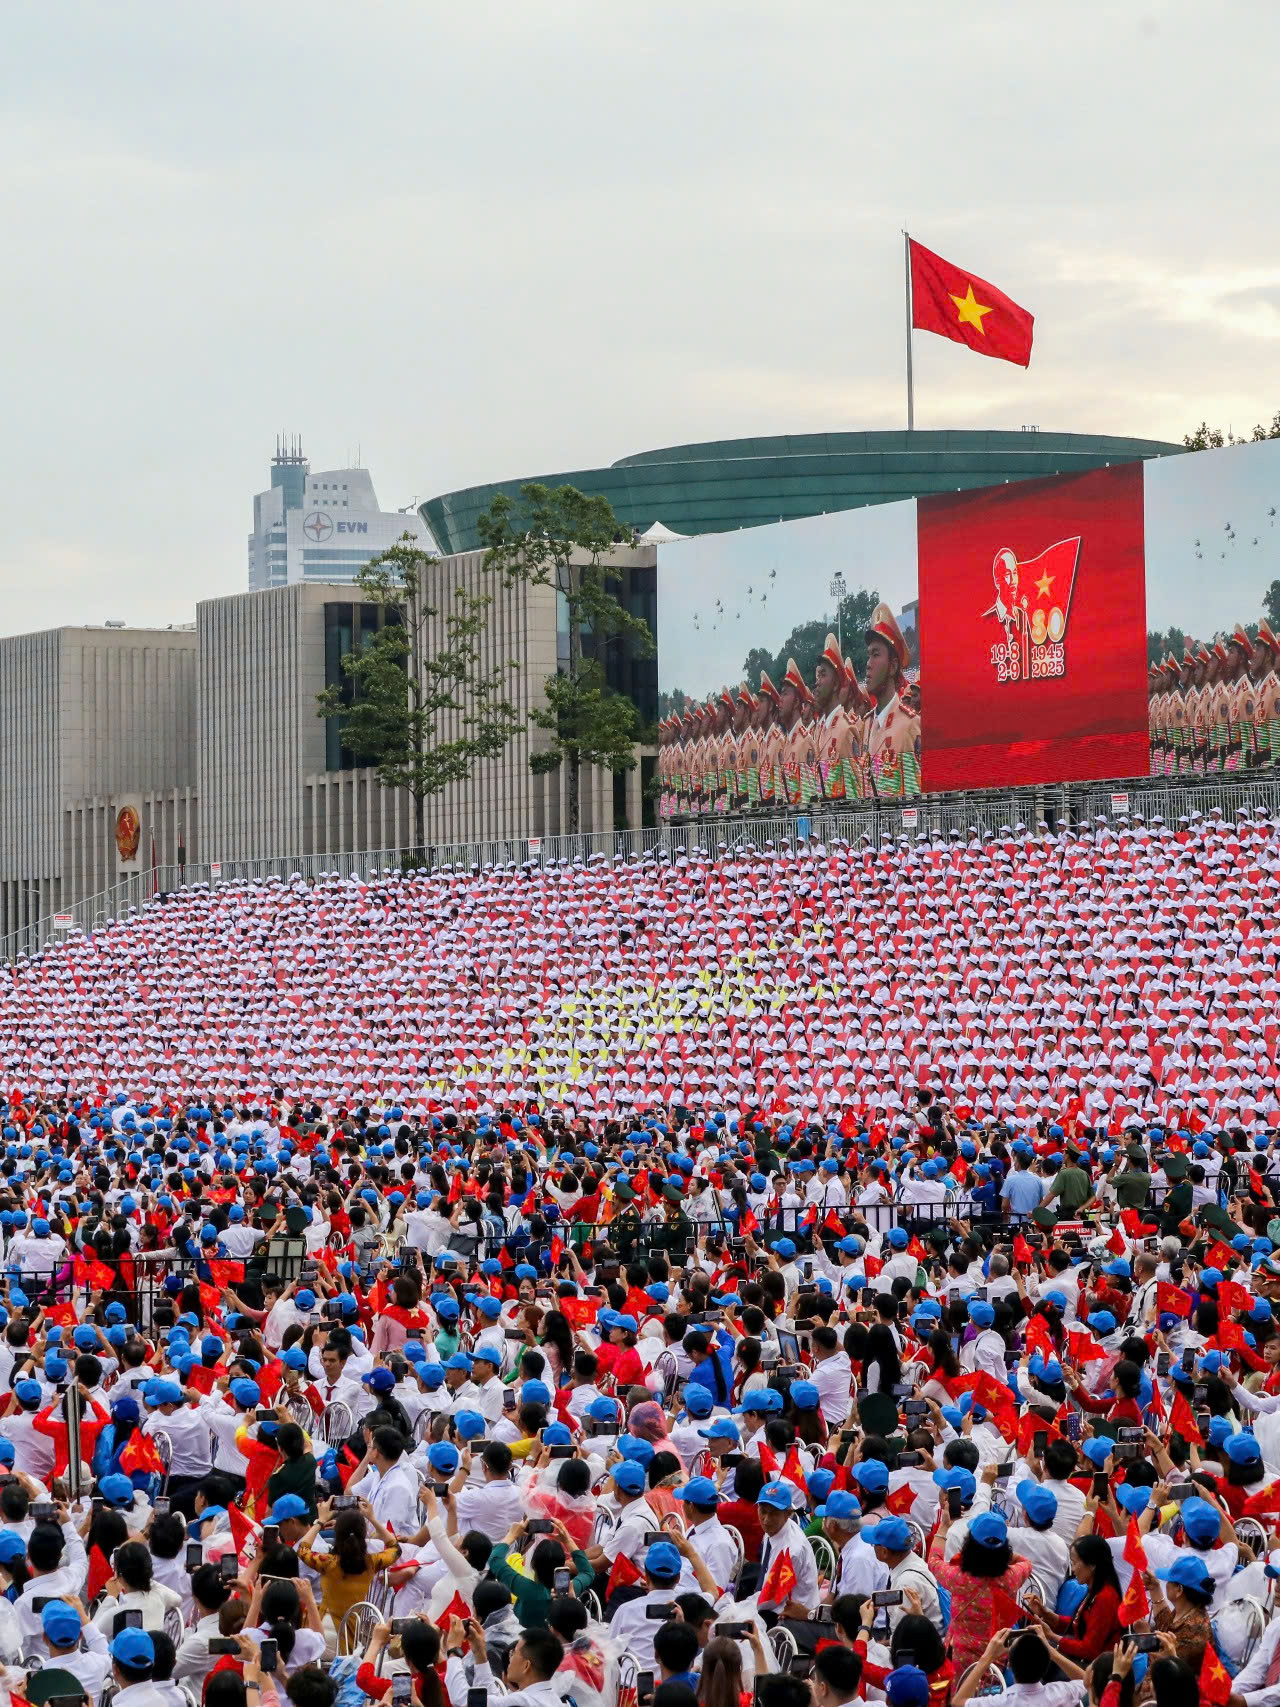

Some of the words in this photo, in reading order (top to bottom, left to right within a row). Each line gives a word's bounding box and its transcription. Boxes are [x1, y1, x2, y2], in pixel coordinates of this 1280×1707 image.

[337, 521, 368, 533] EVN
[1031, 607, 1065, 645] 80
[991, 642, 1020, 664] 19-8
[1031, 643, 1065, 662] 1945
[998, 660, 1020, 681] 2-9
[1032, 660, 1065, 677] 2025
